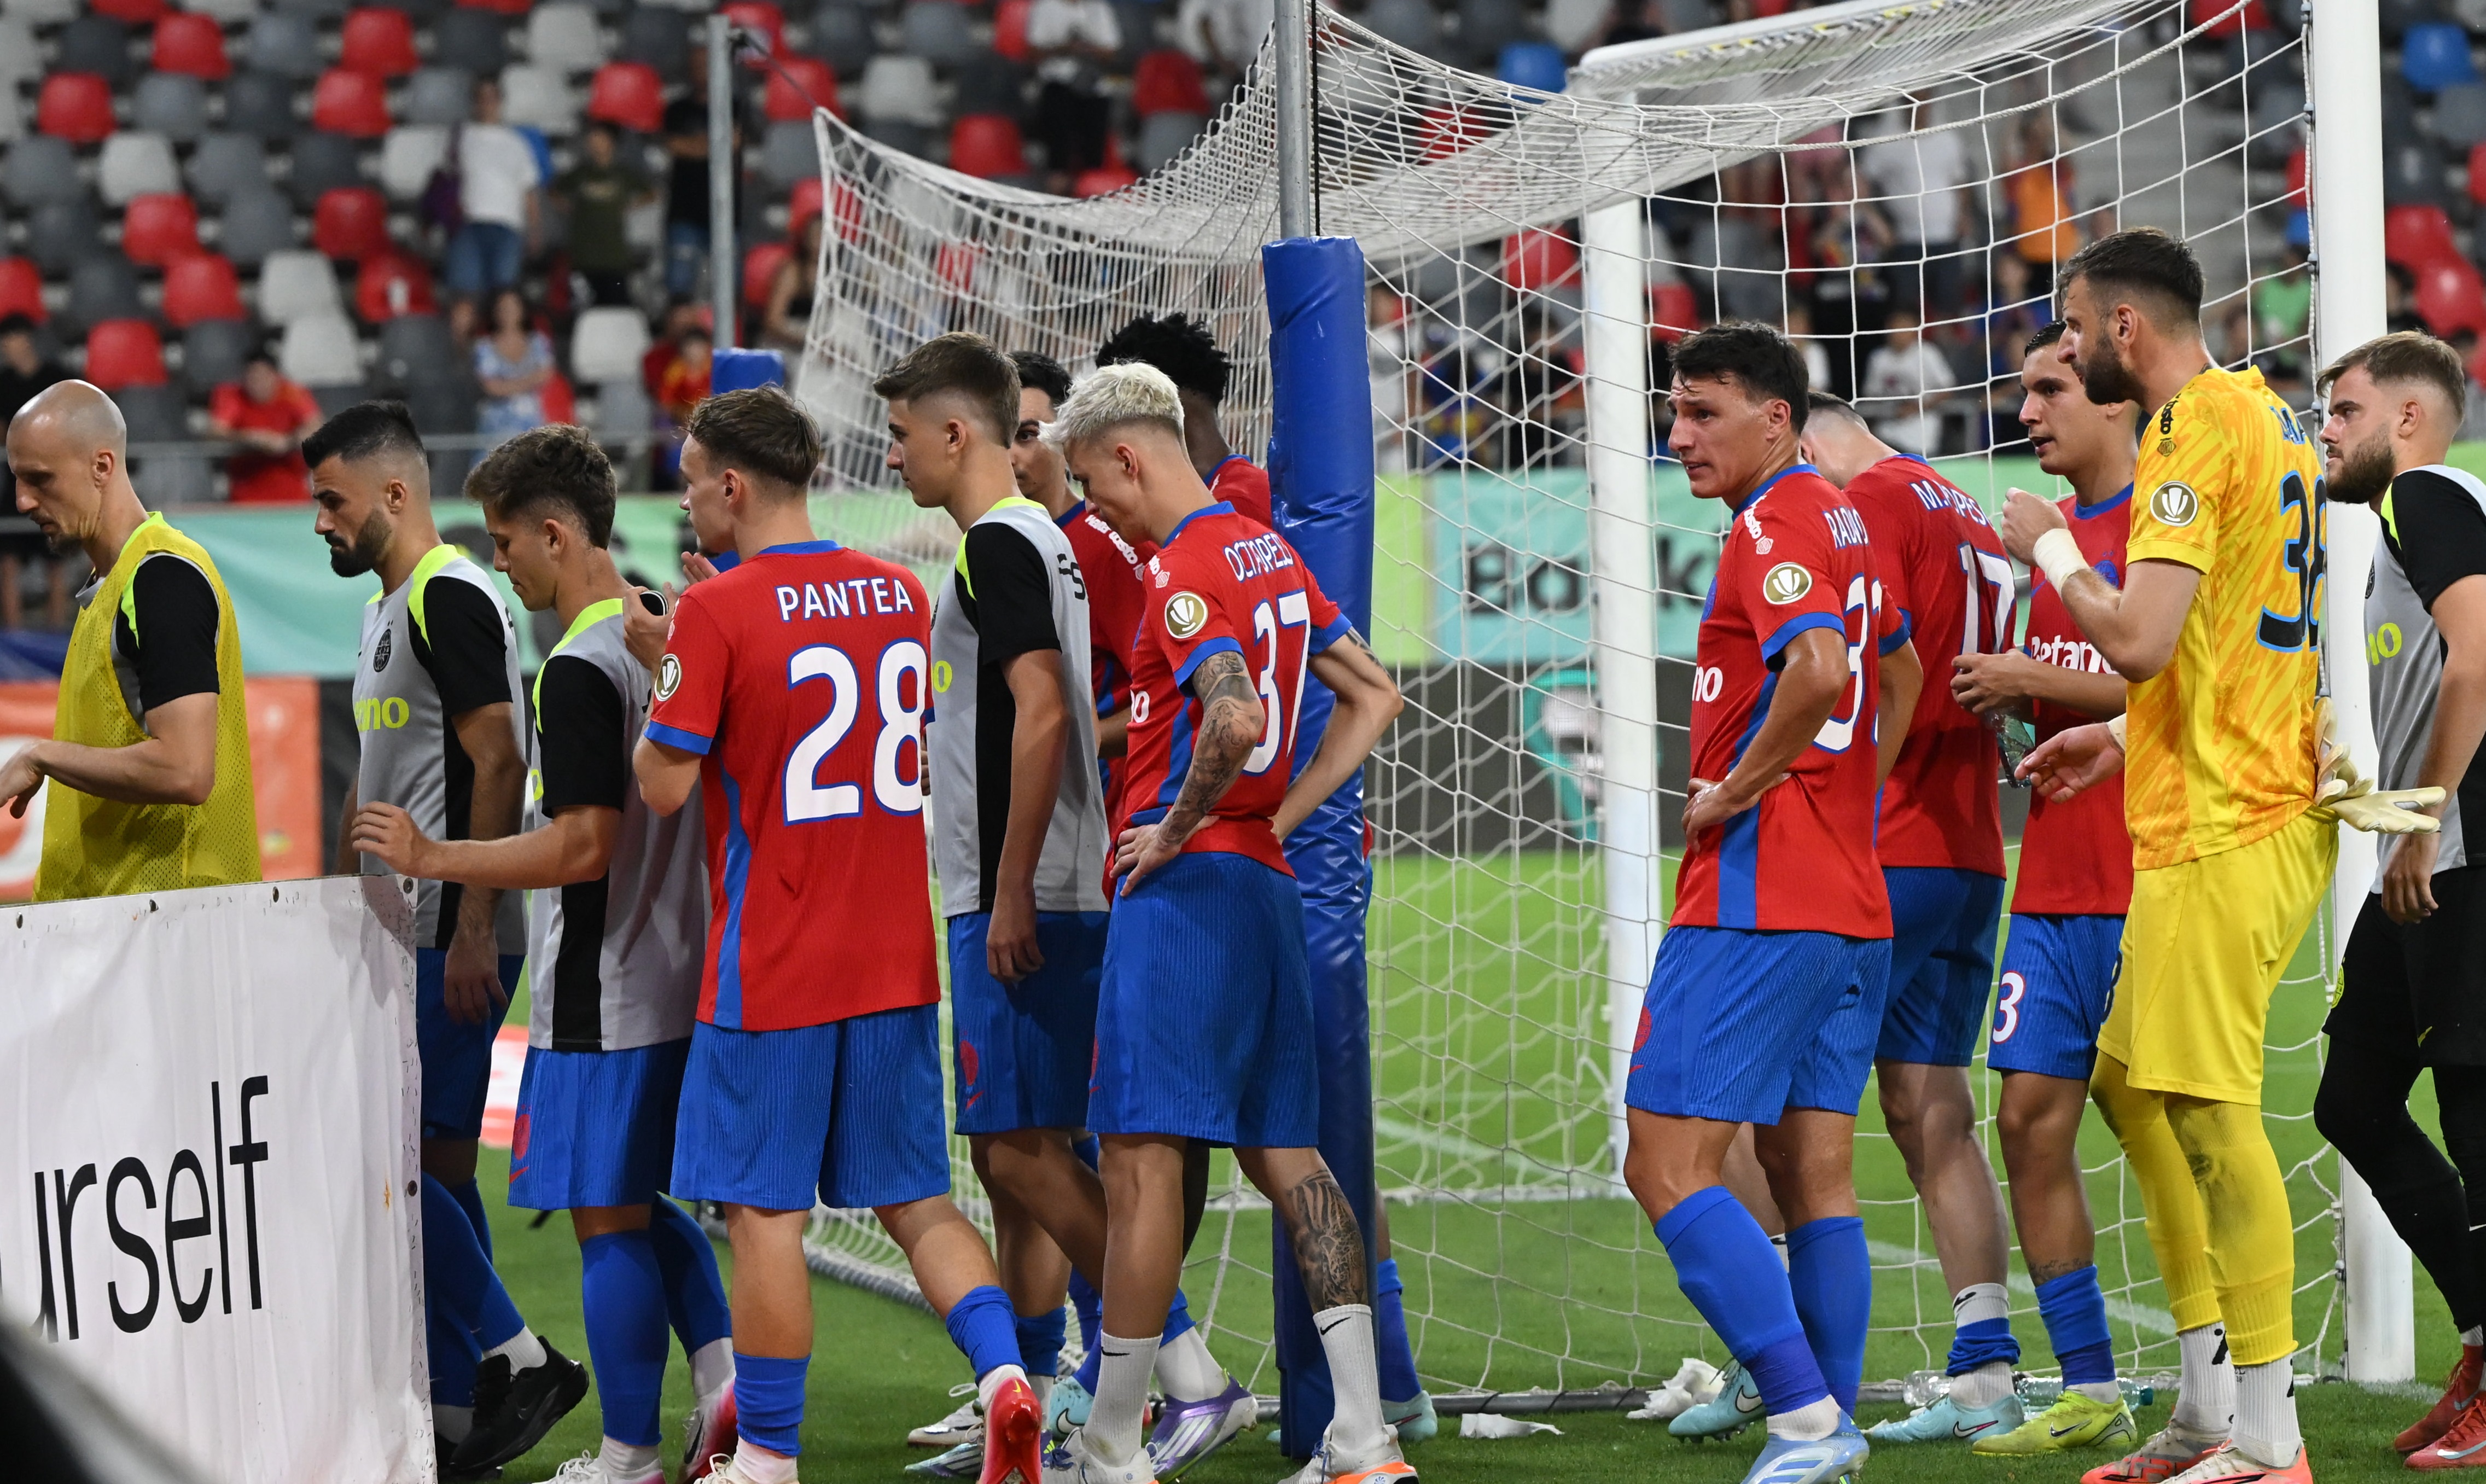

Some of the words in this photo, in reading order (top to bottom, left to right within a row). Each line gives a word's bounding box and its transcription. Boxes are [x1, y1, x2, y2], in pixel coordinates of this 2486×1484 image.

[775, 578, 914, 622] PANTEA
[1957, 540, 2017, 655] 17
[782, 637, 928, 827] 28
[1242, 587, 1311, 777] 37
